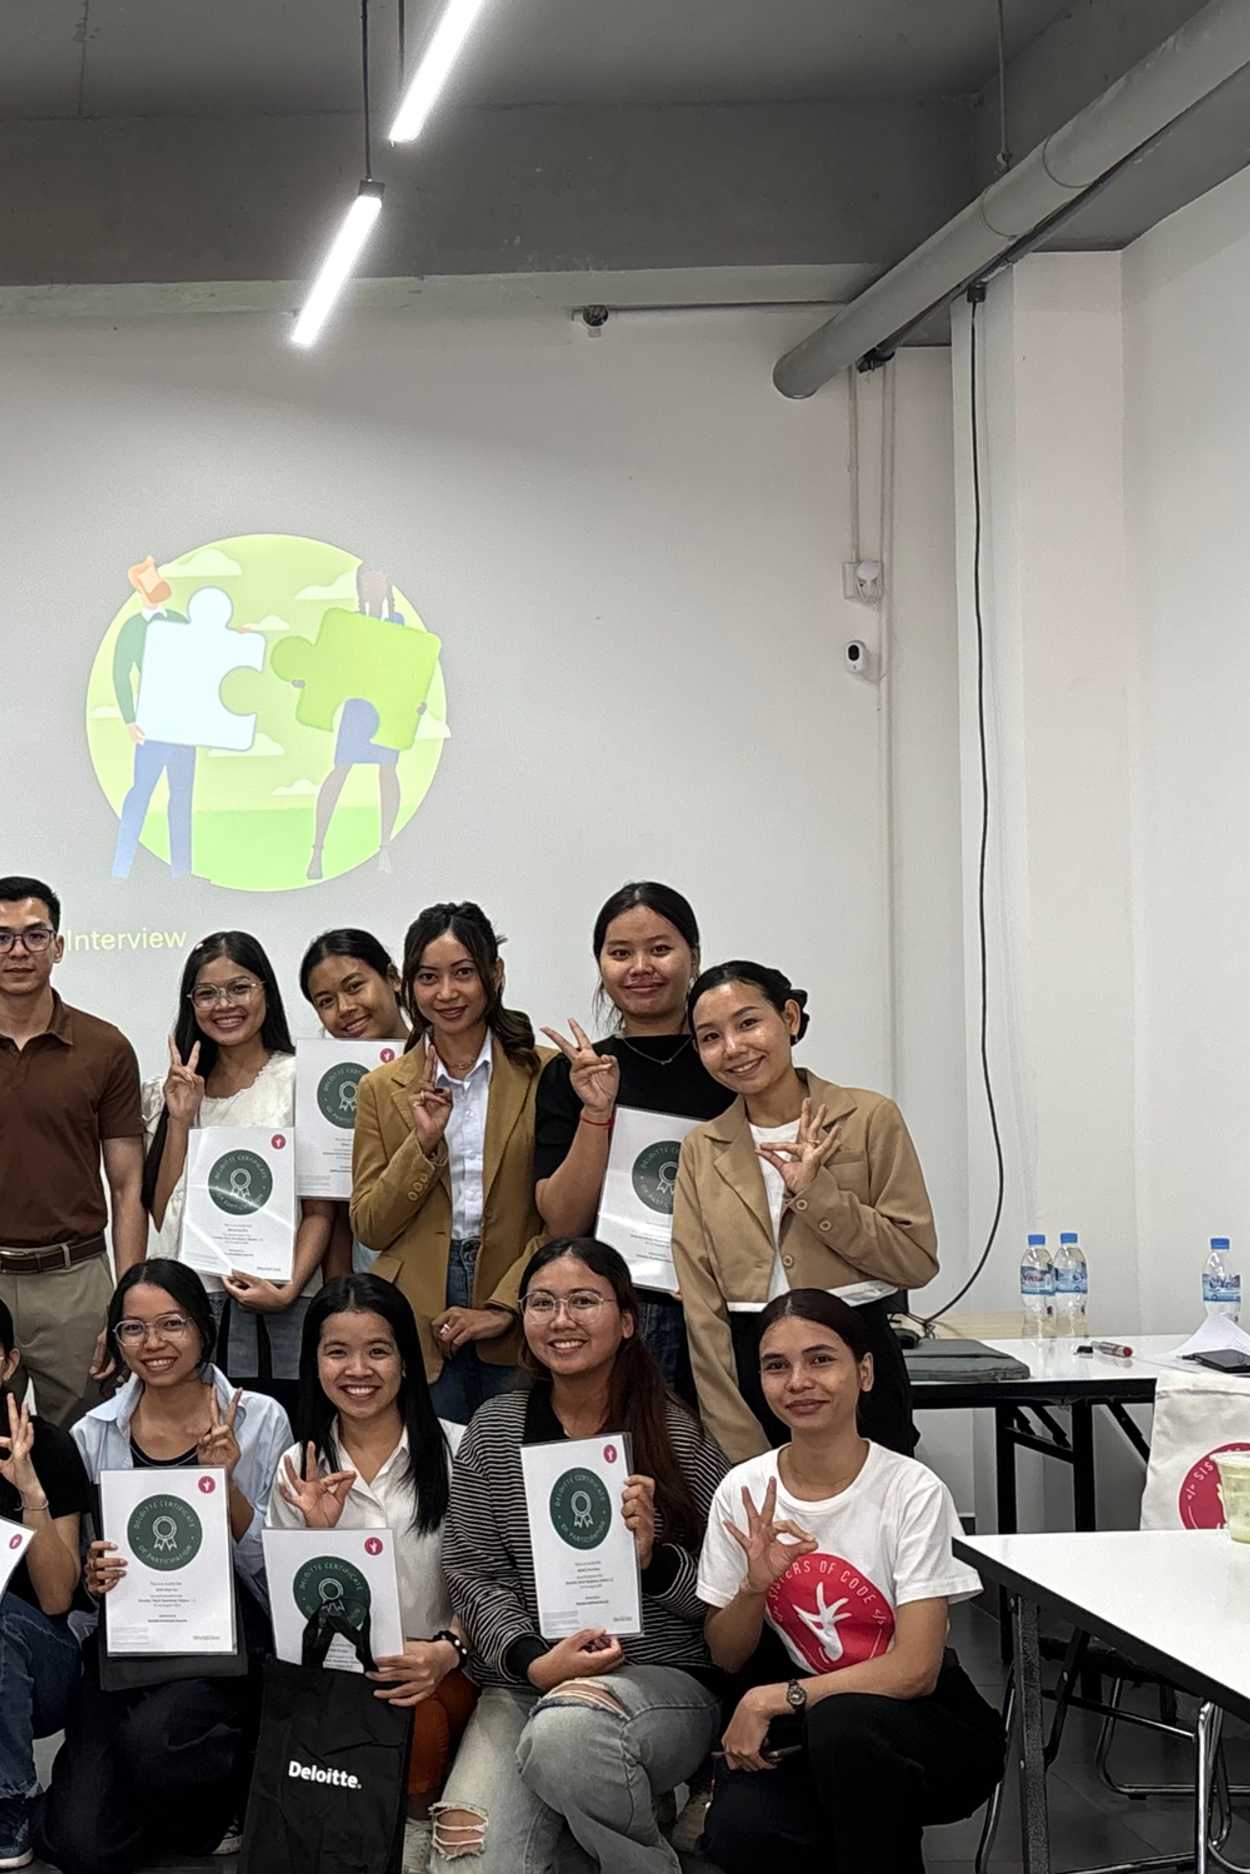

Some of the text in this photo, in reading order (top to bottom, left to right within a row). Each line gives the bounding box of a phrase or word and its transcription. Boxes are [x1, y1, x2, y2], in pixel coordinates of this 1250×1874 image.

[67, 928, 187, 952] Interview
[819, 1560, 837, 1574] OF
[840, 1570, 877, 1604] CODE
[288, 1760, 362, 1789] Deloitte.
